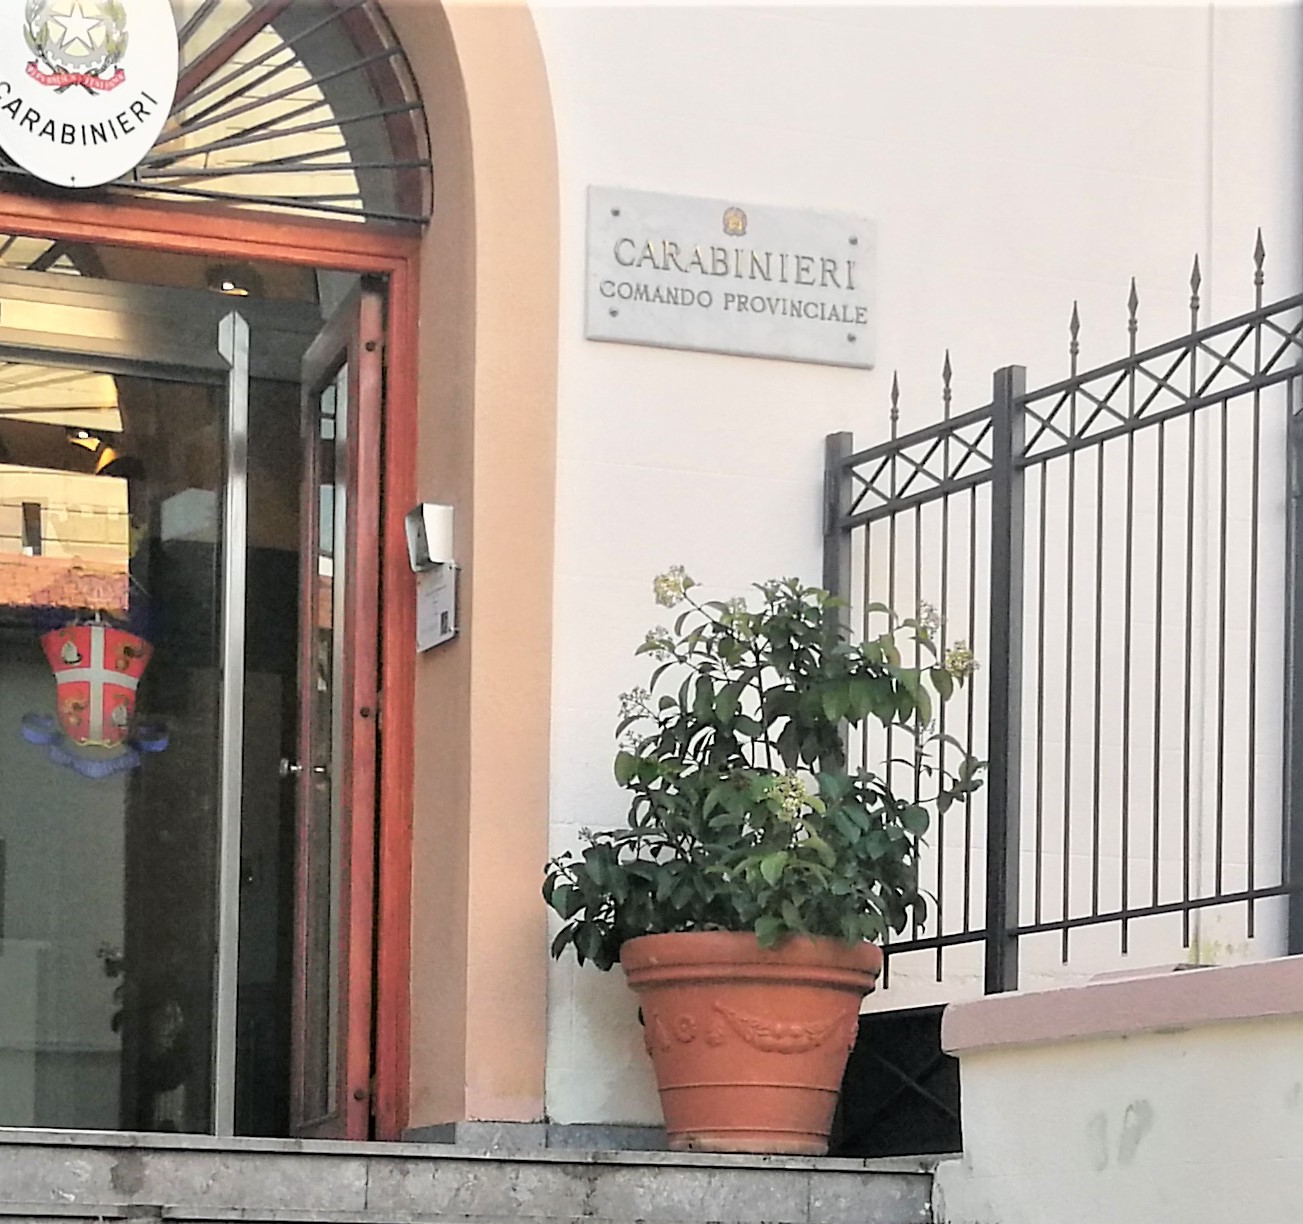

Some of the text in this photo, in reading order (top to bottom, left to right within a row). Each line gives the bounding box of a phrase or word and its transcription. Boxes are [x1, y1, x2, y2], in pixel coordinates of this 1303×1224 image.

[613, 237, 856, 291] CARABINIERI
[599, 280, 868, 325] COMANDO PROVINCIALE
